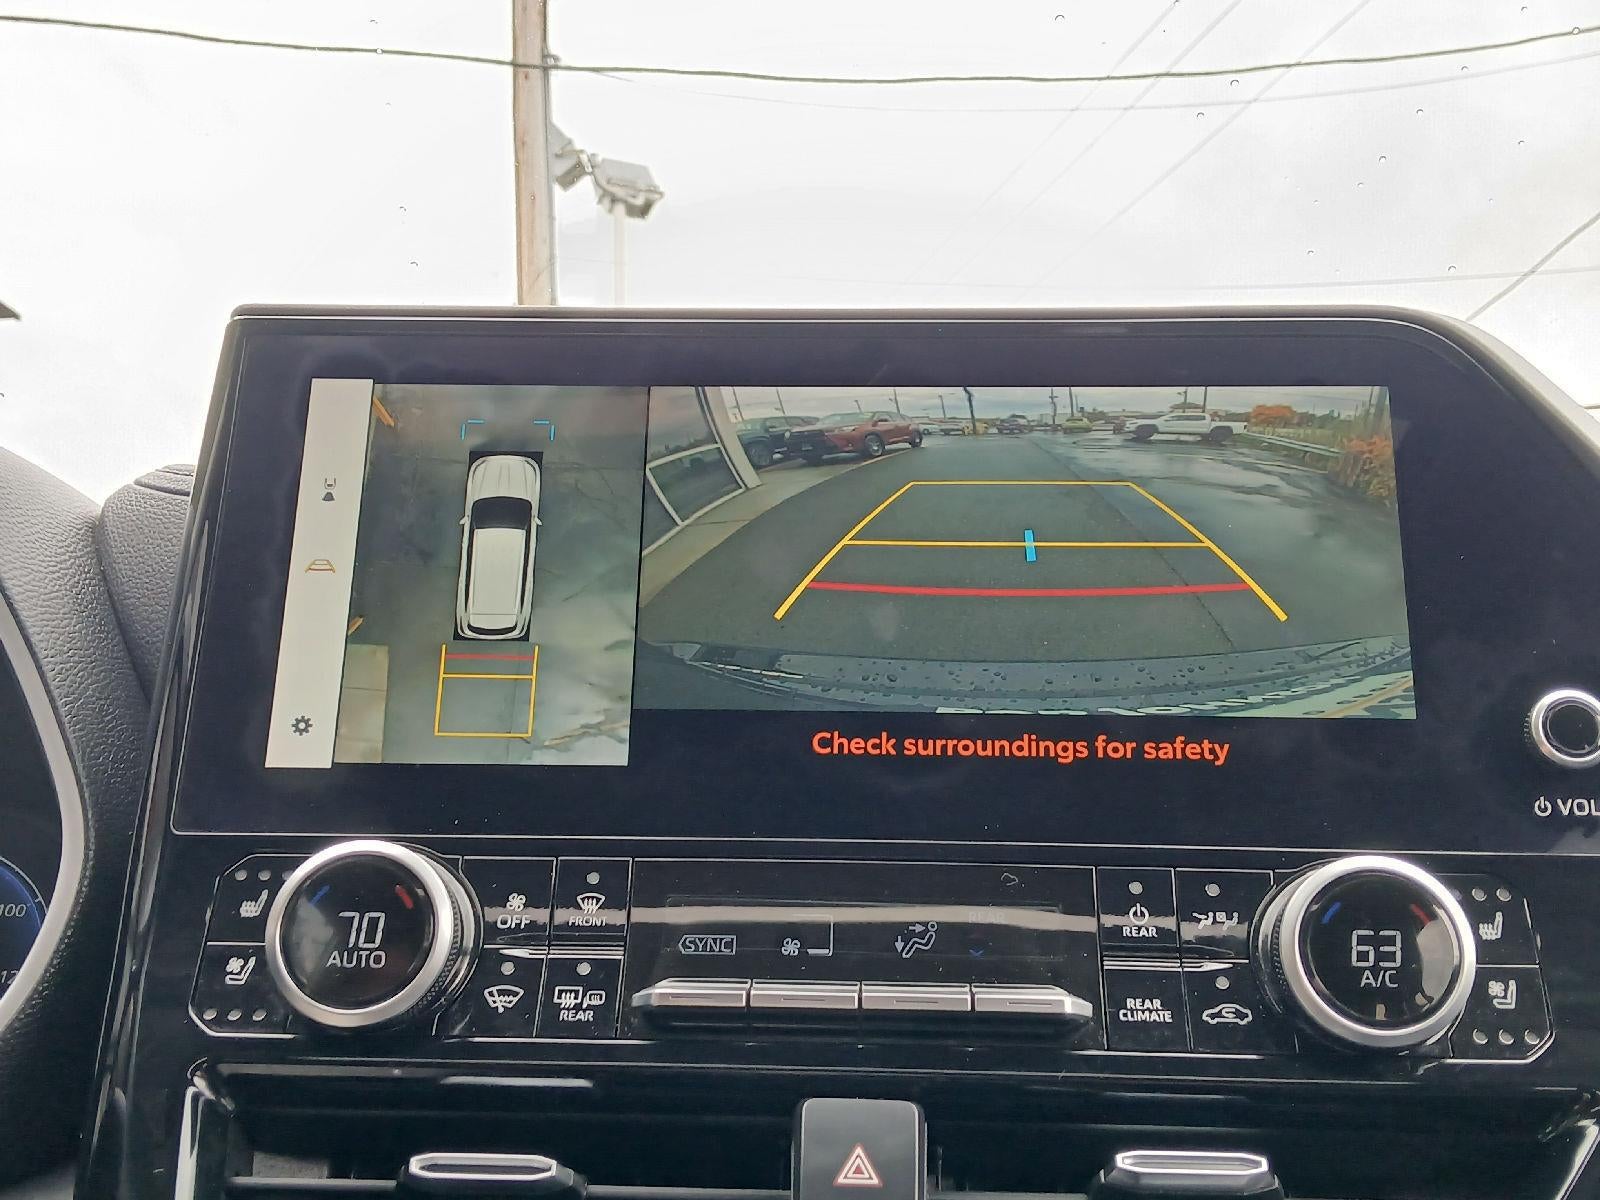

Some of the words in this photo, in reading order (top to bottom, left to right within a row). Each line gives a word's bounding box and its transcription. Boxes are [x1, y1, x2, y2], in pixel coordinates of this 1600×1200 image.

[812, 731, 896, 757] Check
[903, 734, 1088, 764] surroundings
[1095, 734, 1136, 760] for
[1143, 736, 1230, 766] safety
[496, 914, 531, 930] OFF
[568, 915, 608, 928] FRONT
[337, 911, 385, 949] 70
[1122, 925, 1158, 939] REAR
[684, 937, 733, 954] SYNC
[1350, 929, 1402, 969] 63
[325, 950, 386, 970] AUTO
[1360, 969, 1399, 989] A/C
[1126, 997, 1164, 1011] REAR
[559, 1009, 595, 1023] REAR
[1118, 1008, 1174, 1024] CLIMATE
